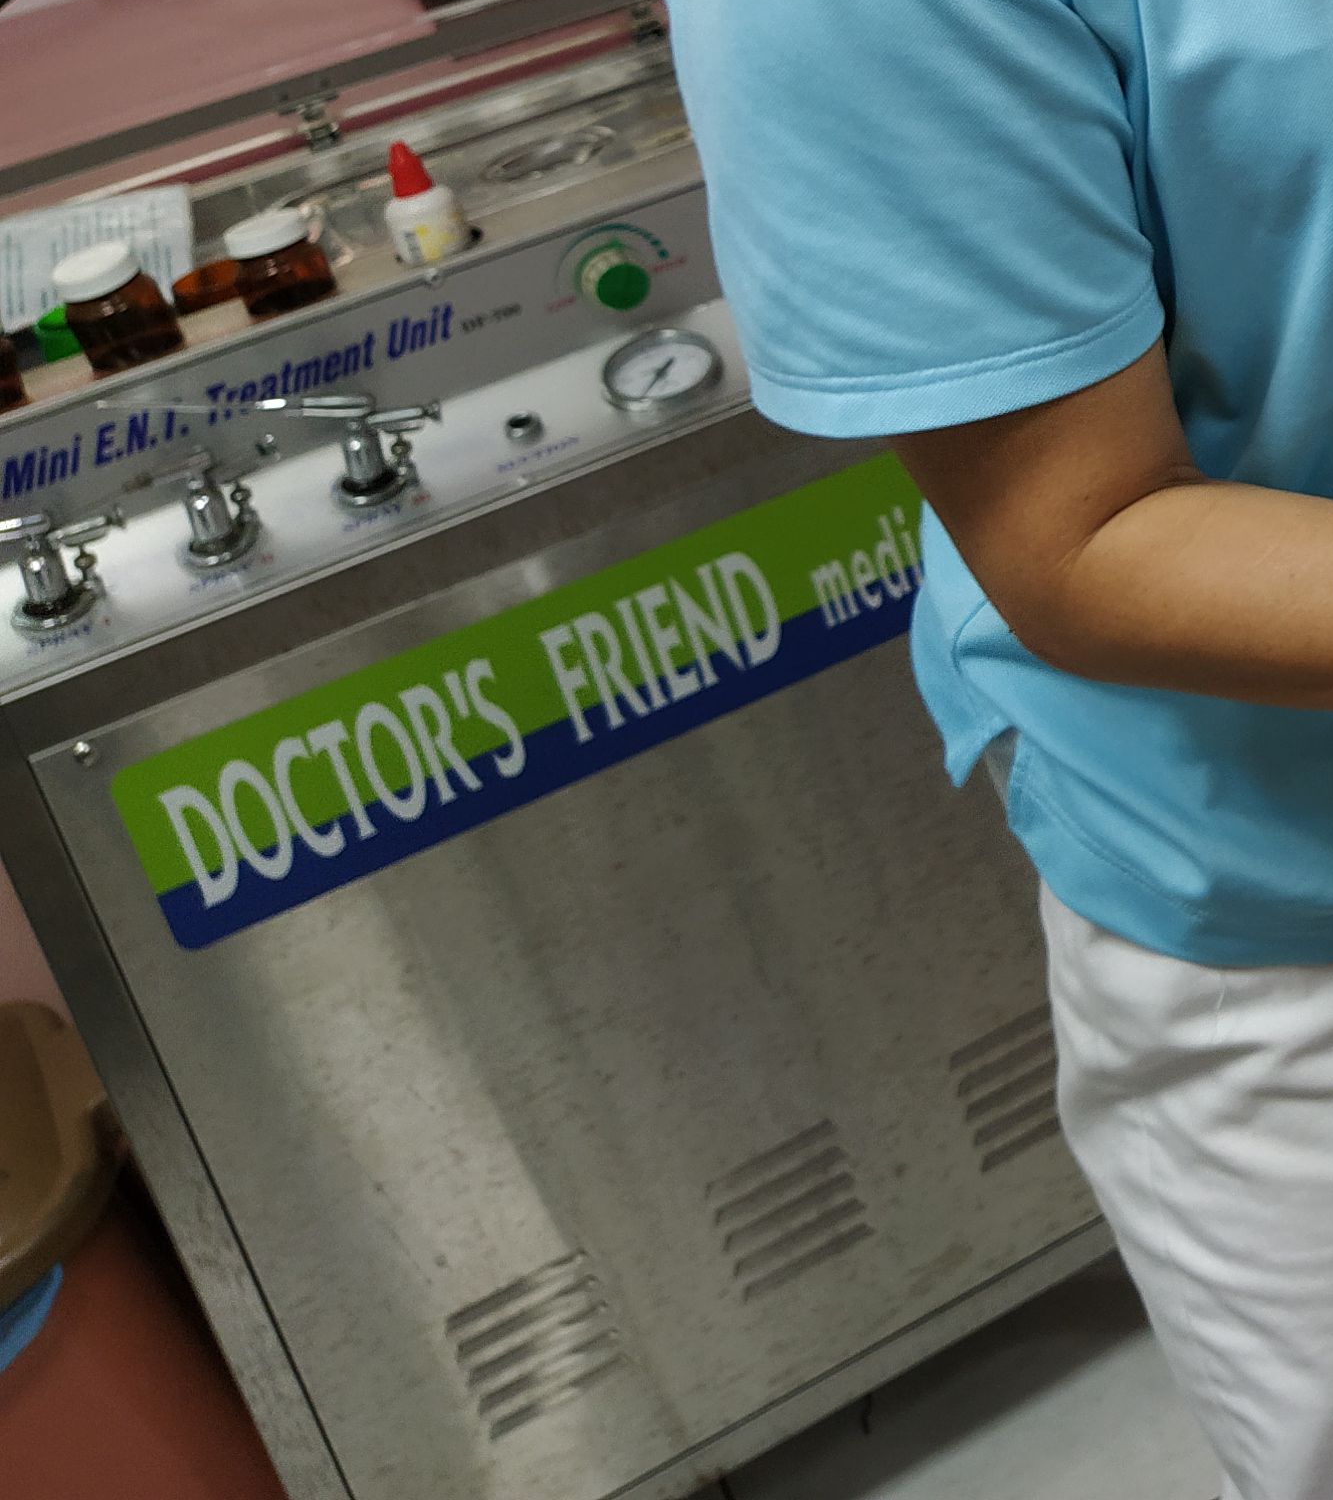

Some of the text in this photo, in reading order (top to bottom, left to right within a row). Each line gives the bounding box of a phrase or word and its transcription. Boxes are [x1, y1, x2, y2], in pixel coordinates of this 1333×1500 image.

[2, 436, 82, 499] Mini
[205, 332, 375, 426] Treatment
[386, 302, 454, 361] Unit
[158, 658, 528, 910] DOCTOR'S
[540, 551, 784, 745] FRIEND
